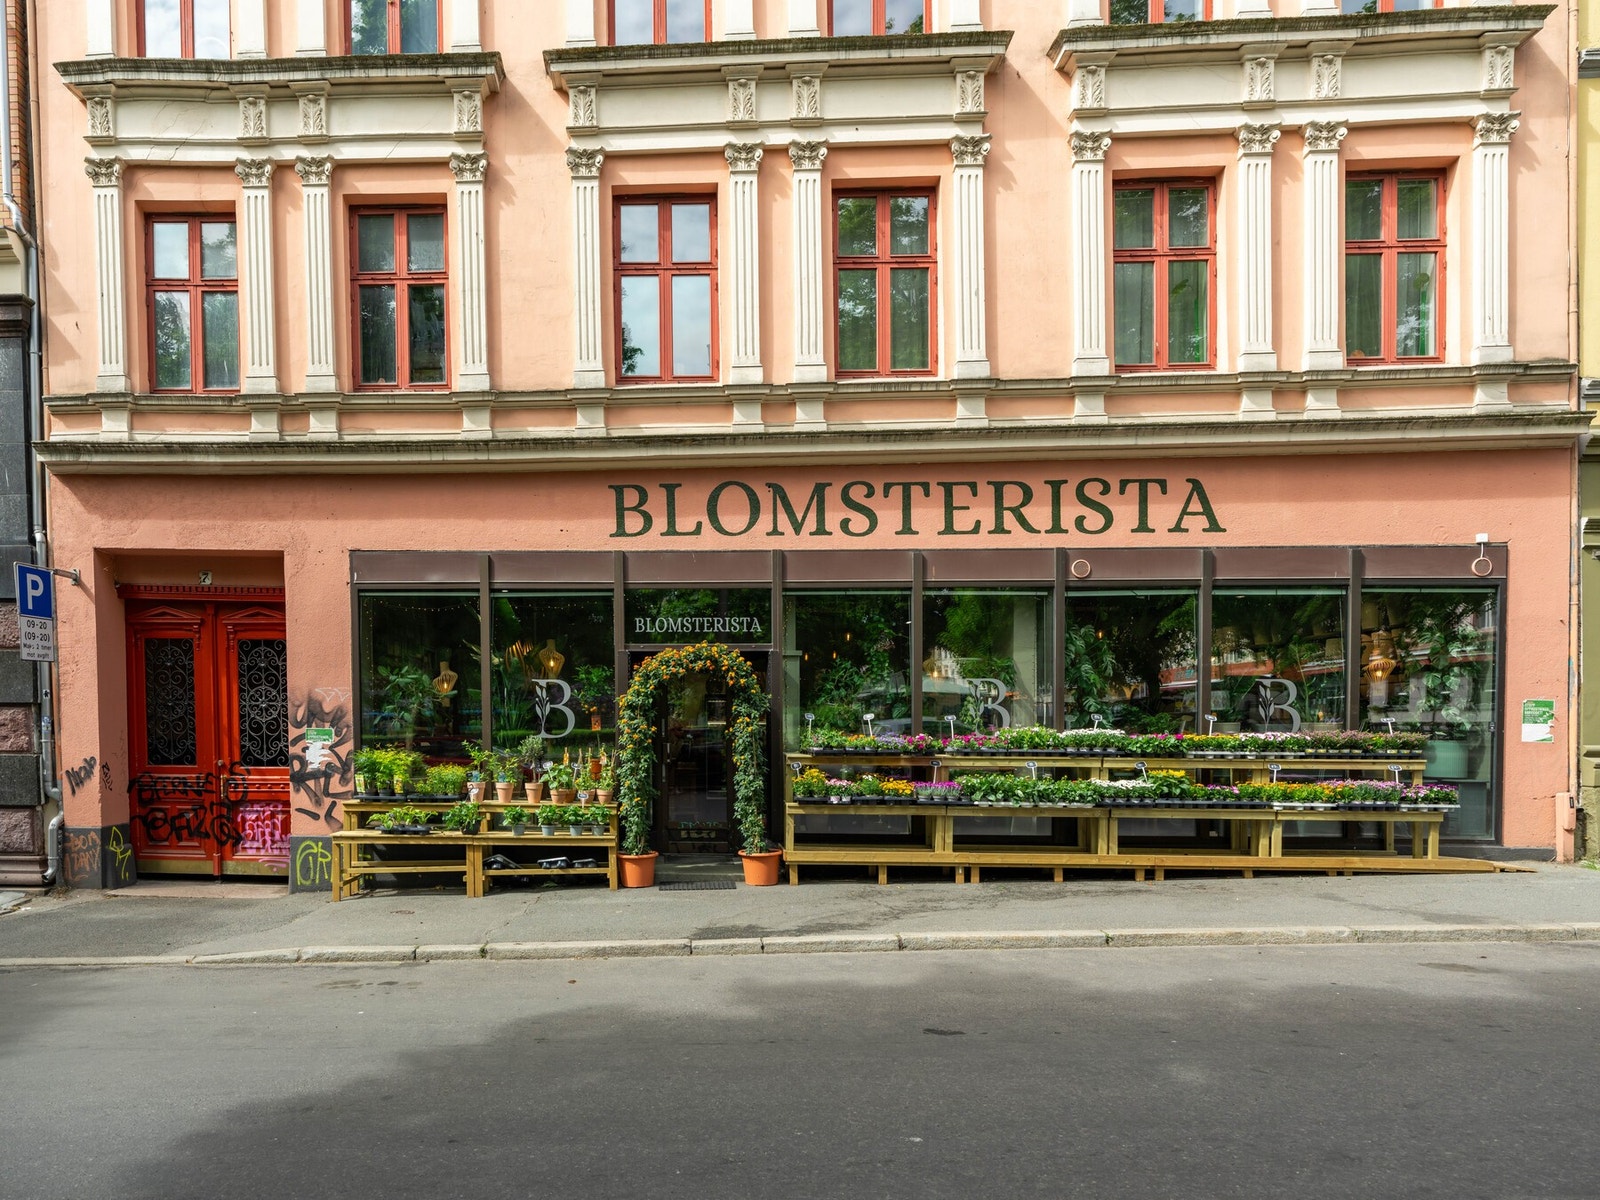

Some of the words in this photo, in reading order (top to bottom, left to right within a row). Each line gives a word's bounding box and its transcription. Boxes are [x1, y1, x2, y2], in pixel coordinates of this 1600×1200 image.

[609, 478, 1227, 538] BLOMSTERISTA
[201, 571, 209, 583] 7
[26, 573, 44, 610] P
[24, 631, 51, 642] (09-20)
[26, 620, 48, 630] 09-20
[634, 616, 763, 634] BLOMSTERISTA
[532, 679, 575, 738] B
[966, 678, 1011, 739] B
